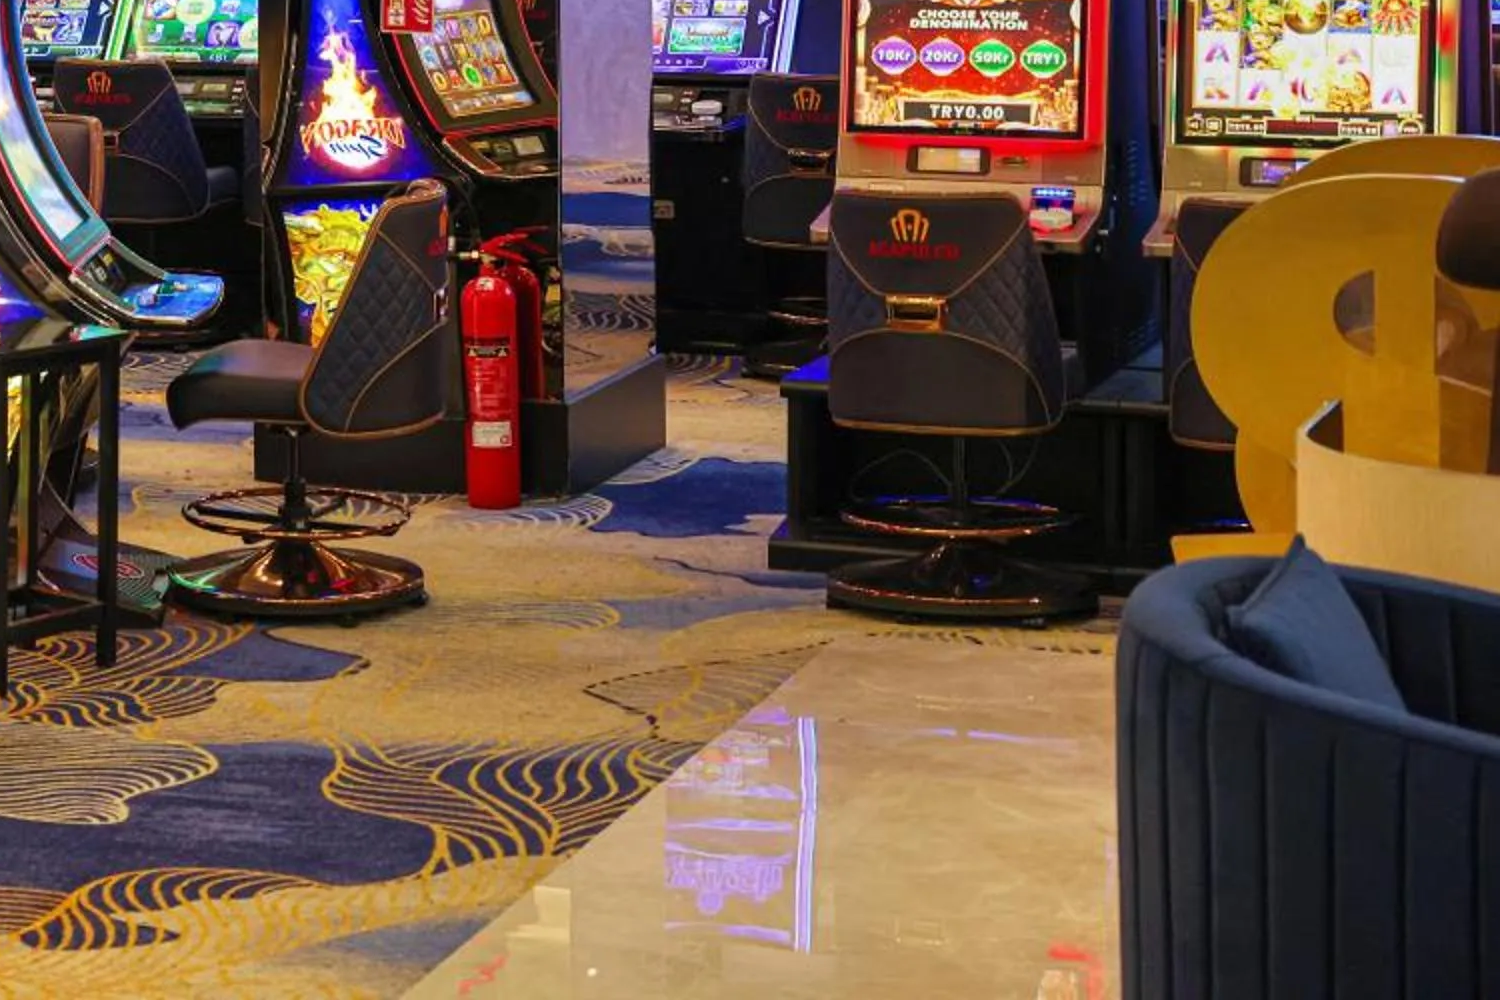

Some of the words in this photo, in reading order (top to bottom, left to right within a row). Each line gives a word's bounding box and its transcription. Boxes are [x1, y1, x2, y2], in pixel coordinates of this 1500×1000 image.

[917, 9, 976, 20] CHOOSE
[980, 9, 1021, 20] YOUR
[909, 19, 1029, 31] DENOMINATION
[1026, 51, 1061, 64] TRY1
[929, 104, 1005, 120] TRY0.00
